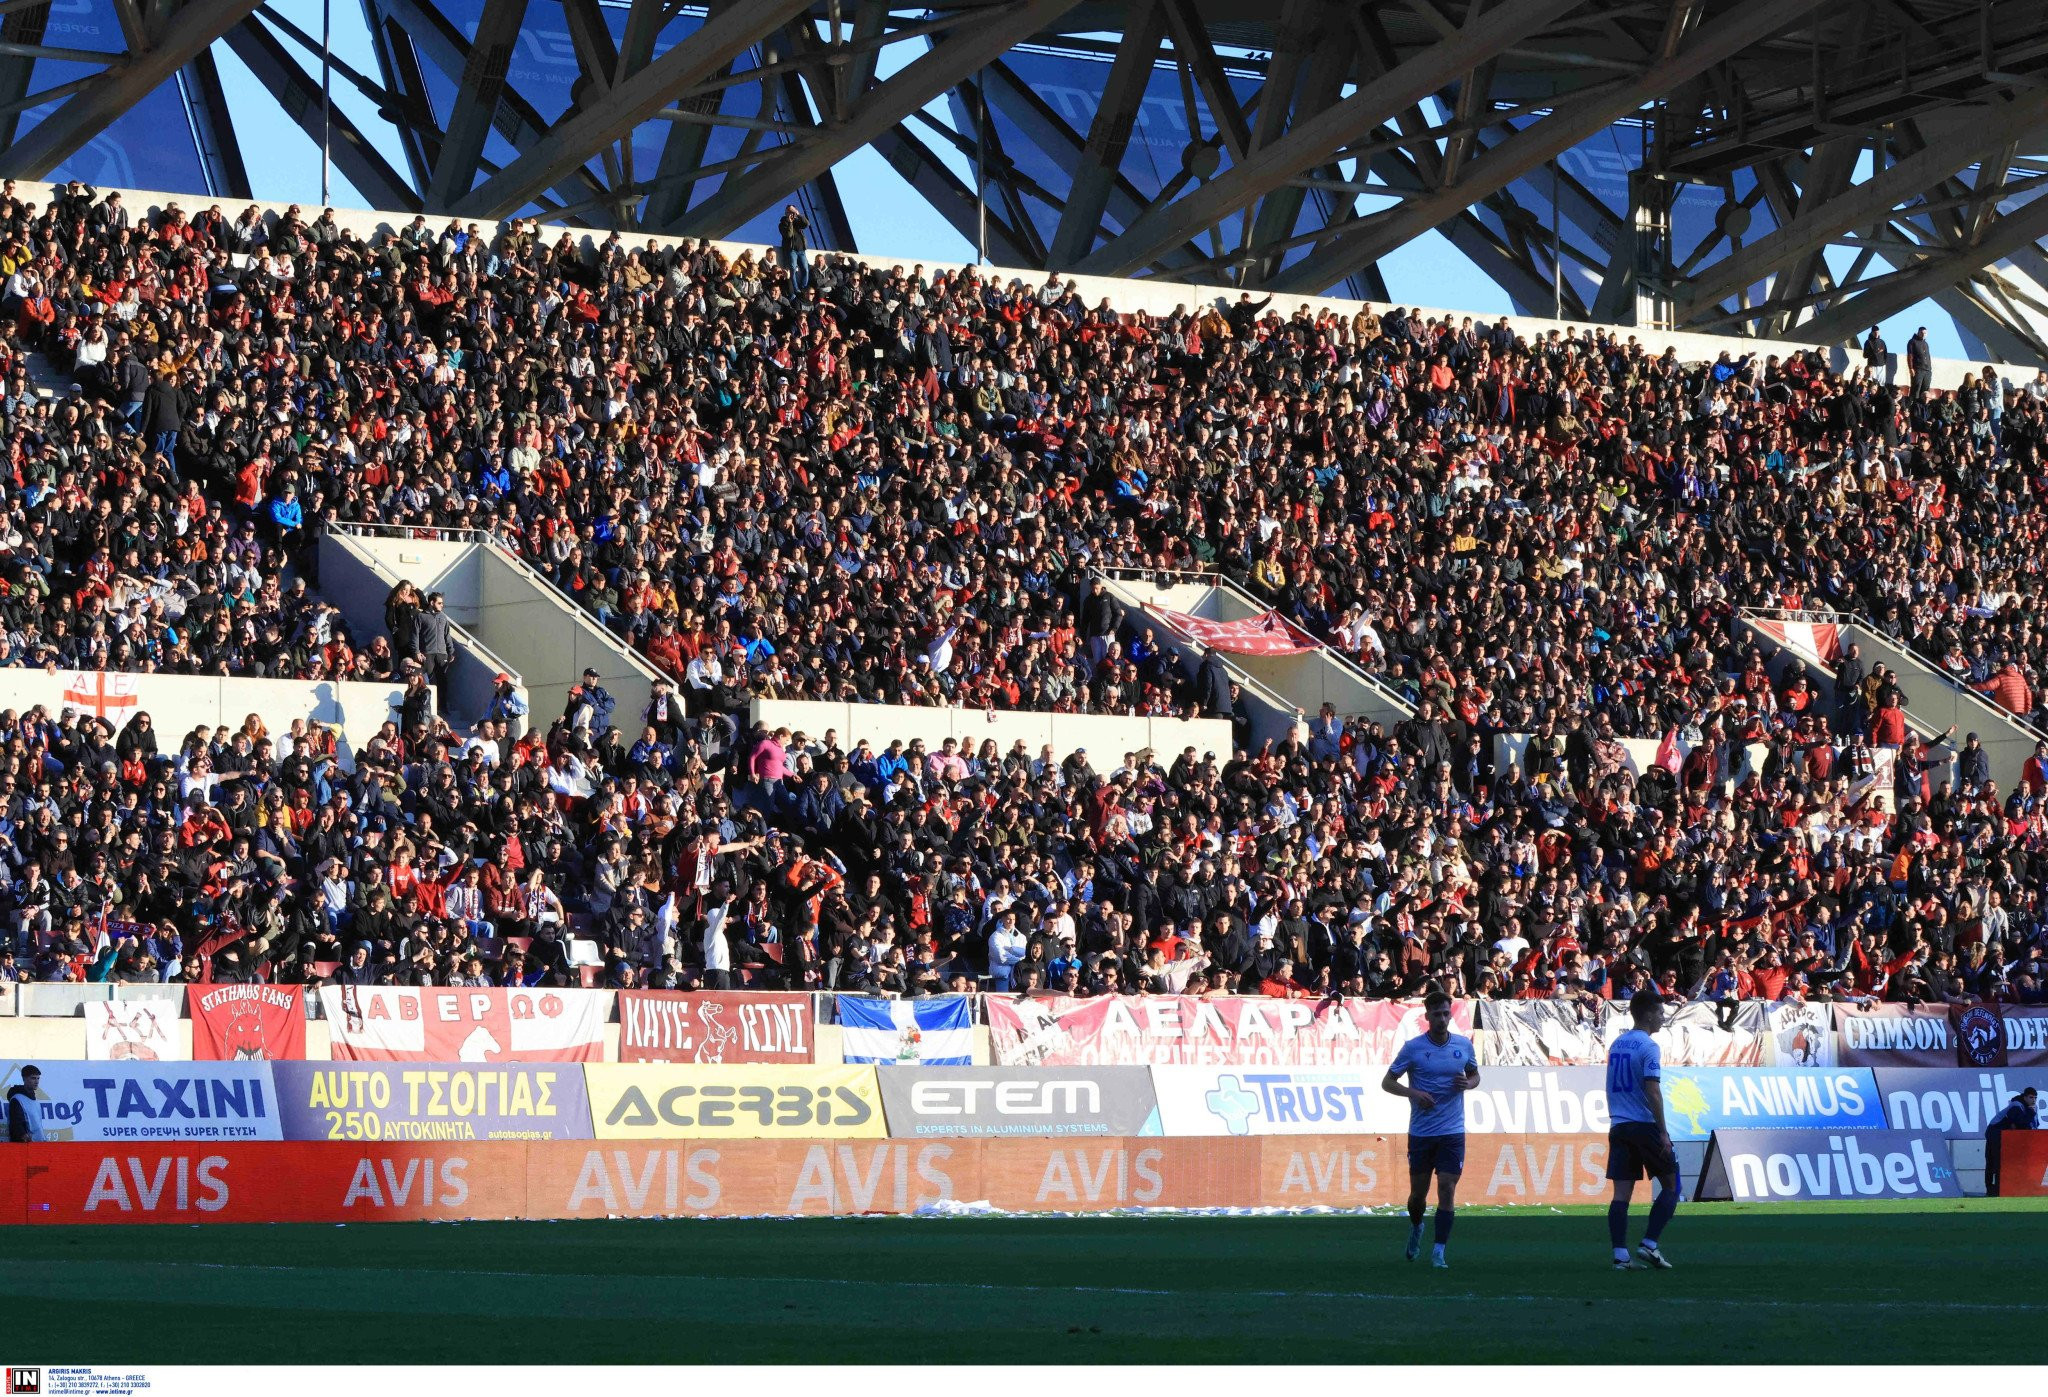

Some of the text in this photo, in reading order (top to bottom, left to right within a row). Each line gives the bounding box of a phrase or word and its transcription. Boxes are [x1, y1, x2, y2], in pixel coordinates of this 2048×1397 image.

[201, 984, 293, 1012] STATHMOS FANS
[625, 997, 693, 1050] KATE
[1844, 1016, 1947, 1051] CRIMSON
[402, 1071, 557, 1117] ΤΣΟΓΙΑΣ
[911, 1080, 1101, 1114] ETEM
[1464, 1071, 1611, 1133] ovibe
[1722, 1075, 1865, 1117] ANIMUS
[103, 1127, 138, 1137] SUPER
[184, 1127, 219, 1137] SUPER
[325, 1111, 476, 1140] 250 ΑΥΤΟΚΙΝΗΤΑ
[488, 1128, 553, 1140] autotsogias.gr
[916, 1122, 1108, 1134] EXPERTS IN ALUMINIUM SYSTEMS
[83, 1155, 230, 1211] AVIS
[342, 1157, 470, 1207] AVIS
[566, 1149, 721, 1211] AVIS
[787, 1143, 955, 1211] AVIS
[1034, 1148, 1164, 1202] AVIS
[1279, 1150, 1378, 1194] AVIS
[1485, 1143, 1608, 1197] AVIS
[1730, 1135, 1952, 1197] novibet 21+
